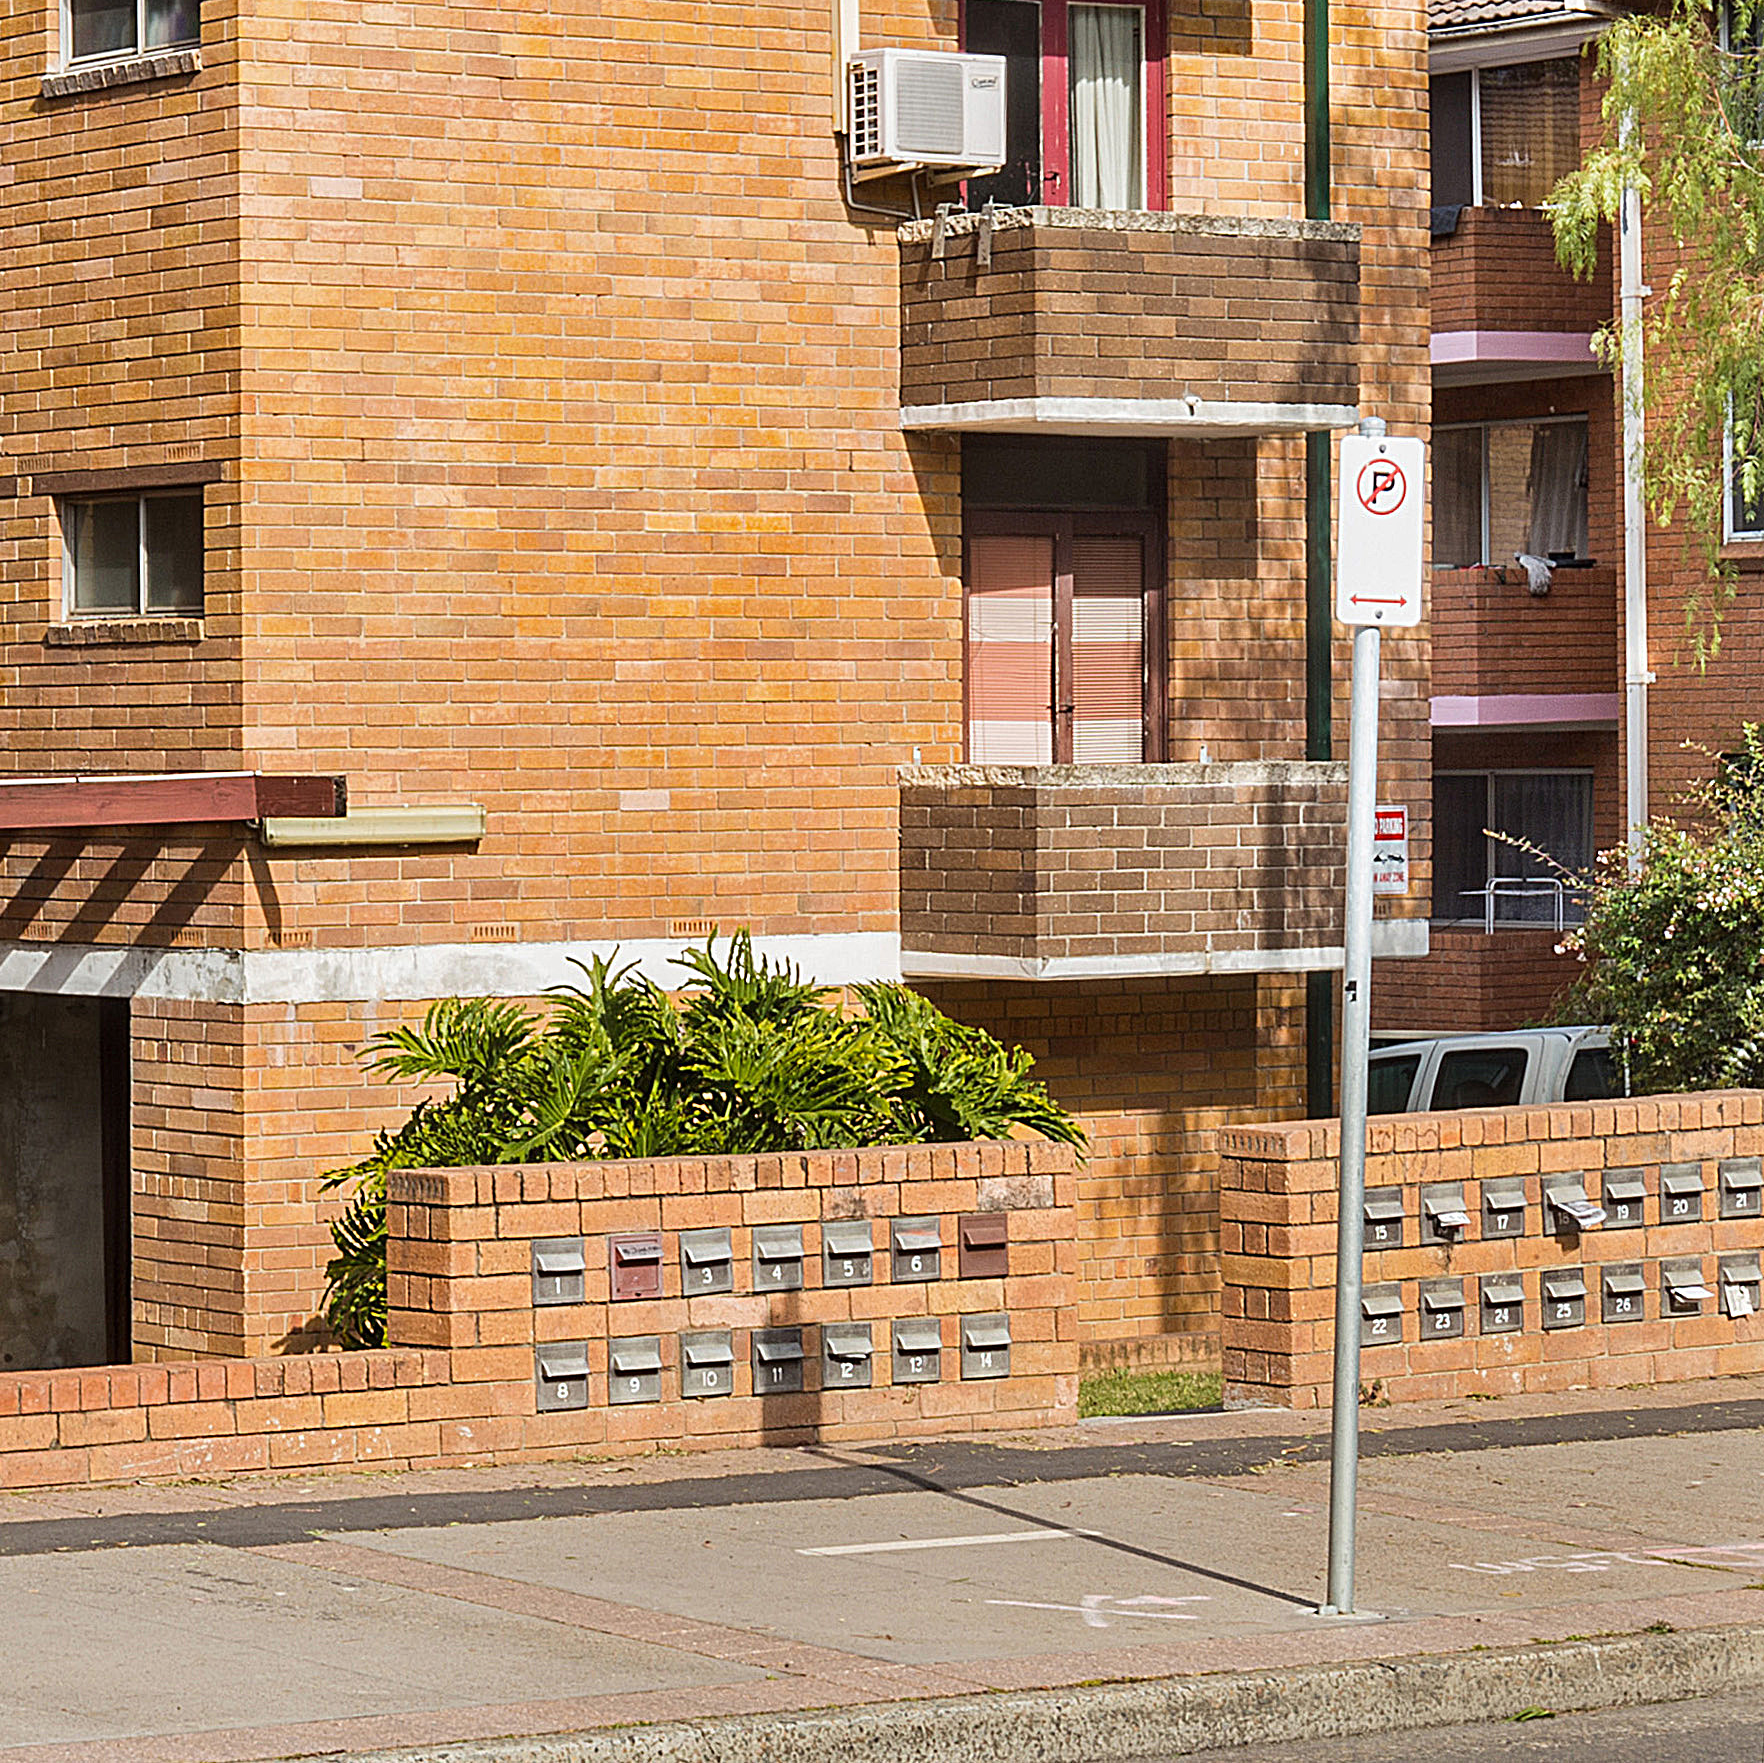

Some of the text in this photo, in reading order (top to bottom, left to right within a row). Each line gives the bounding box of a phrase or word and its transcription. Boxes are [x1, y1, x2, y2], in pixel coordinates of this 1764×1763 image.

[1372, 471, 1395, 505] P
[1673, 1199, 1689, 1215] 20
[1736, 1193, 1748, 1208] 21
[1617, 1204, 1629, 1220] 19
[1497, 1214, 1509, 1230] 17
[1374, 1225, 1388, 1240] 15
[843, 1260, 854, 1277] 5
[911, 1256, 922, 1272] 6
[701, 1268, 713, 1285] 3
[771, 1264, 782, 1281] 4
[554, 1277, 561, 1294] 1
[1556, 1303, 1572, 1319] 25
[1616, 1298, 1632, 1314] 26
[1435, 1313, 1451, 1329] 23
[1494, 1308, 1510, 1324] 24
[1372, 1318, 1387, 1335] 22
[910, 1356, 923, 1373] 13
[980, 1352, 992, 1368] 14
[772, 1367, 783, 1383] 11
[840, 1363, 854, 1378] 12
[629, 1377, 640, 1393] 9
[702, 1371, 718, 1387] 10
[557, 1383, 569, 1399] 8
